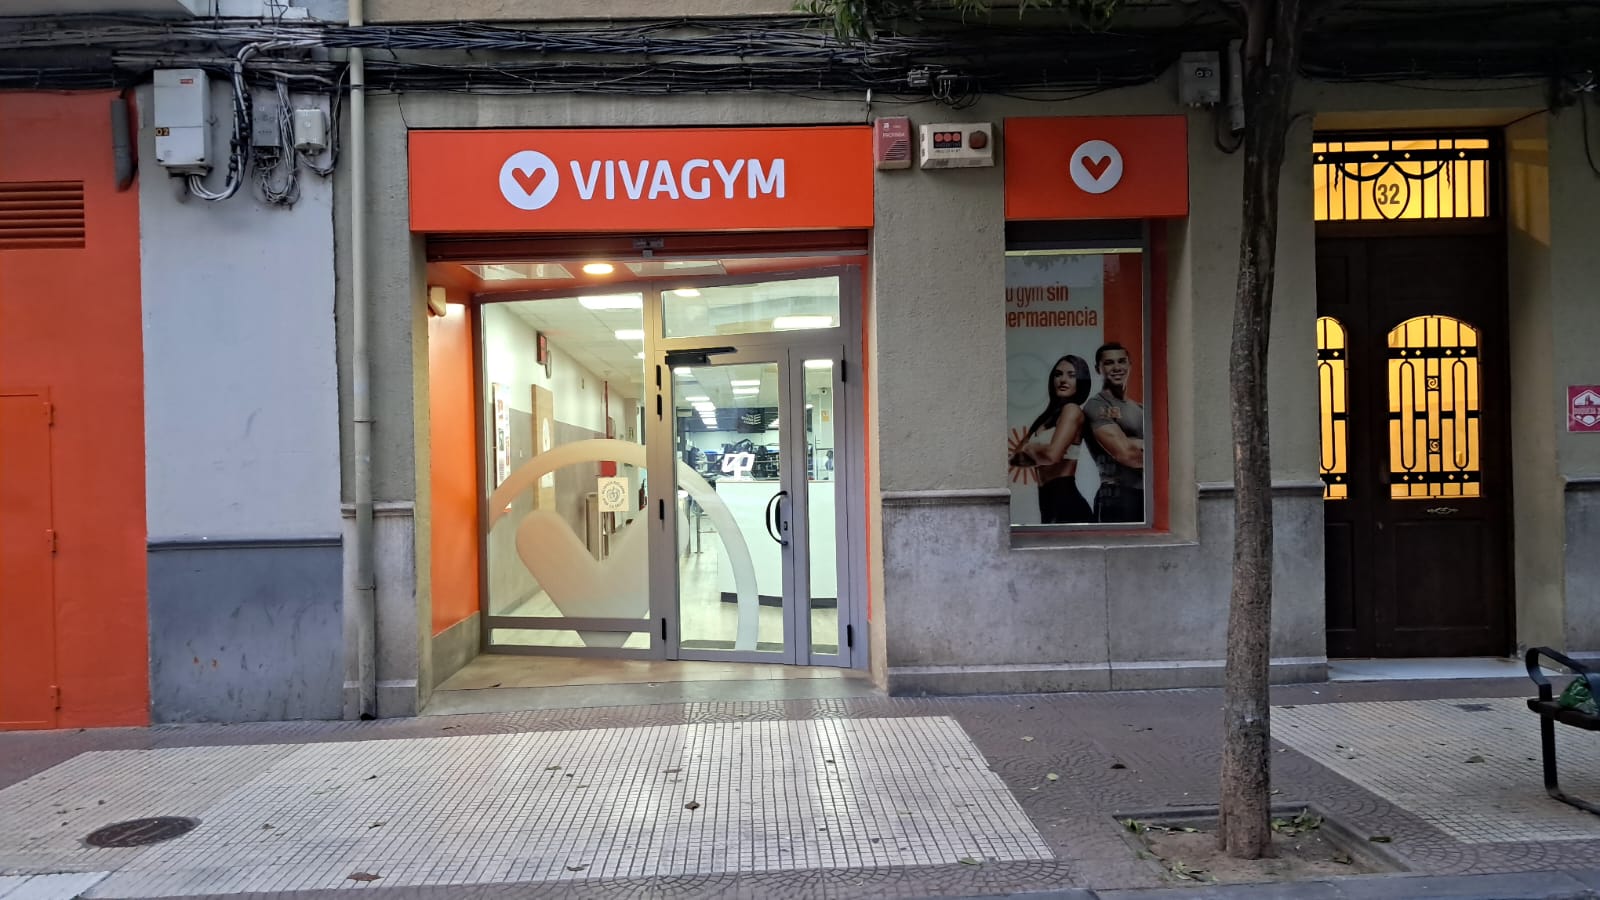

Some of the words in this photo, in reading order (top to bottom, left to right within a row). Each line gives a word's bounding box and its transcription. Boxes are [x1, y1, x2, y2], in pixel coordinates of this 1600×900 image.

[569, 157, 786, 200] VIVAGYM
[1377, 183, 1401, 205] 32
[1016, 286, 1044, 308] gym
[1047, 281, 1069, 302] sin
[1006, 307, 1098, 328] ermanencia
